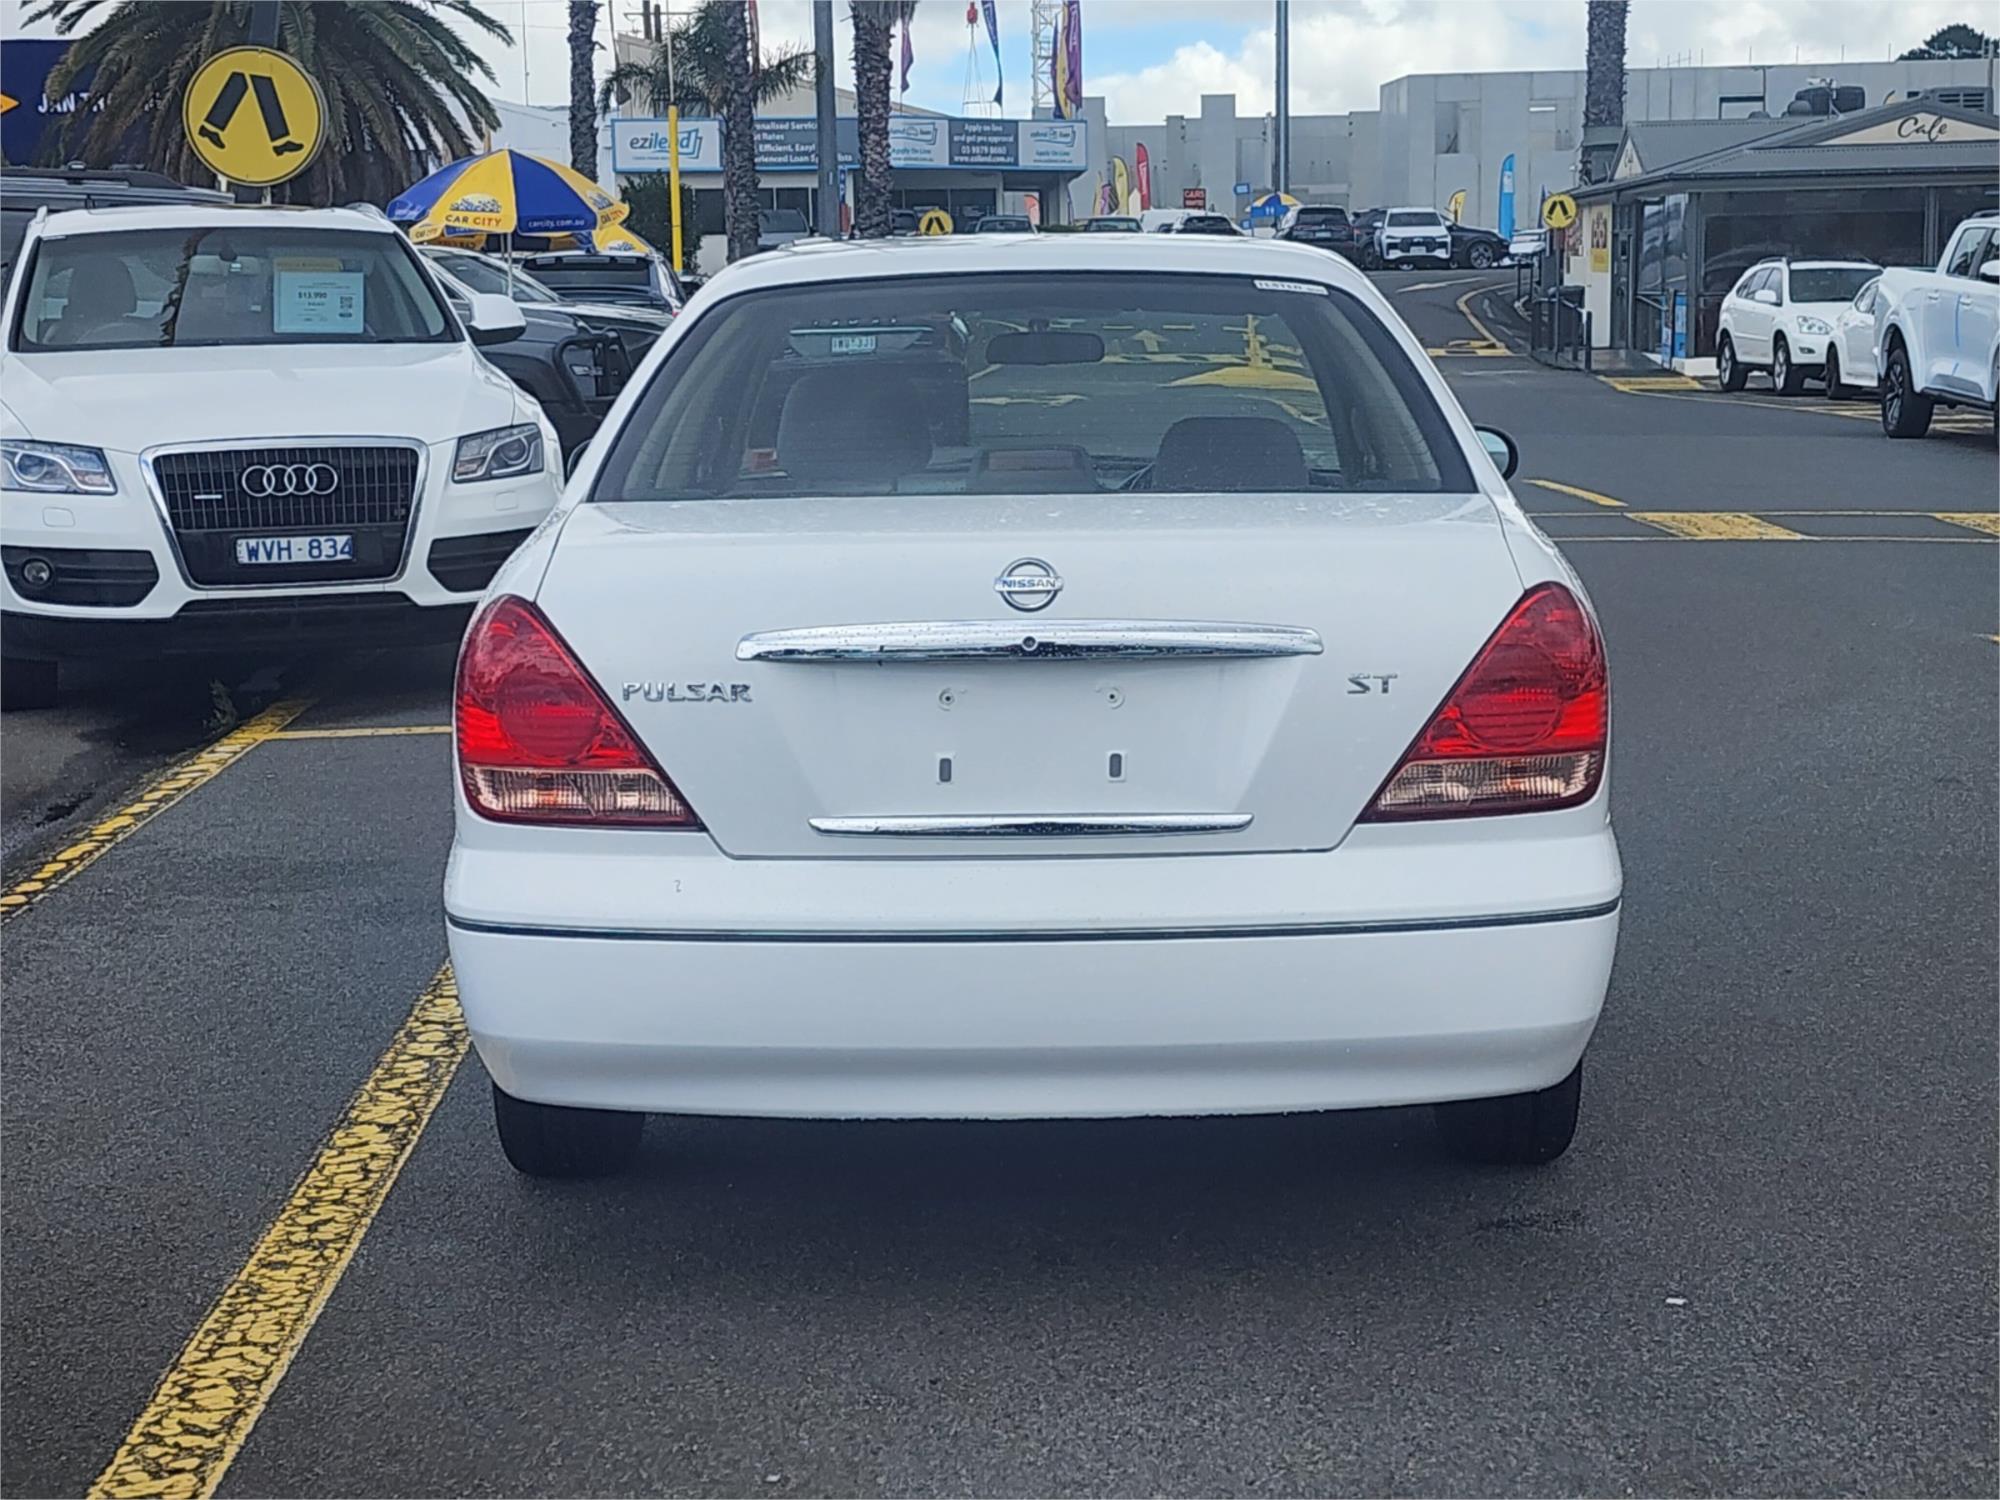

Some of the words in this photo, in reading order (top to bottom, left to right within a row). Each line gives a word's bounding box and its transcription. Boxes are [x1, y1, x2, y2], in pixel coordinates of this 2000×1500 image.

[1897, 115, 1948, 142] Cafe
[629, 132, 692, 149] eziled
[445, 214, 469, 223] CAR
[473, 216, 502, 227] CITY
[528, 218, 585, 229] carcity.com.au
[1002, 579, 1056, 588] NISSAN
[622, 681, 753, 702] PULSAR
[1346, 673, 1398, 694] ST
